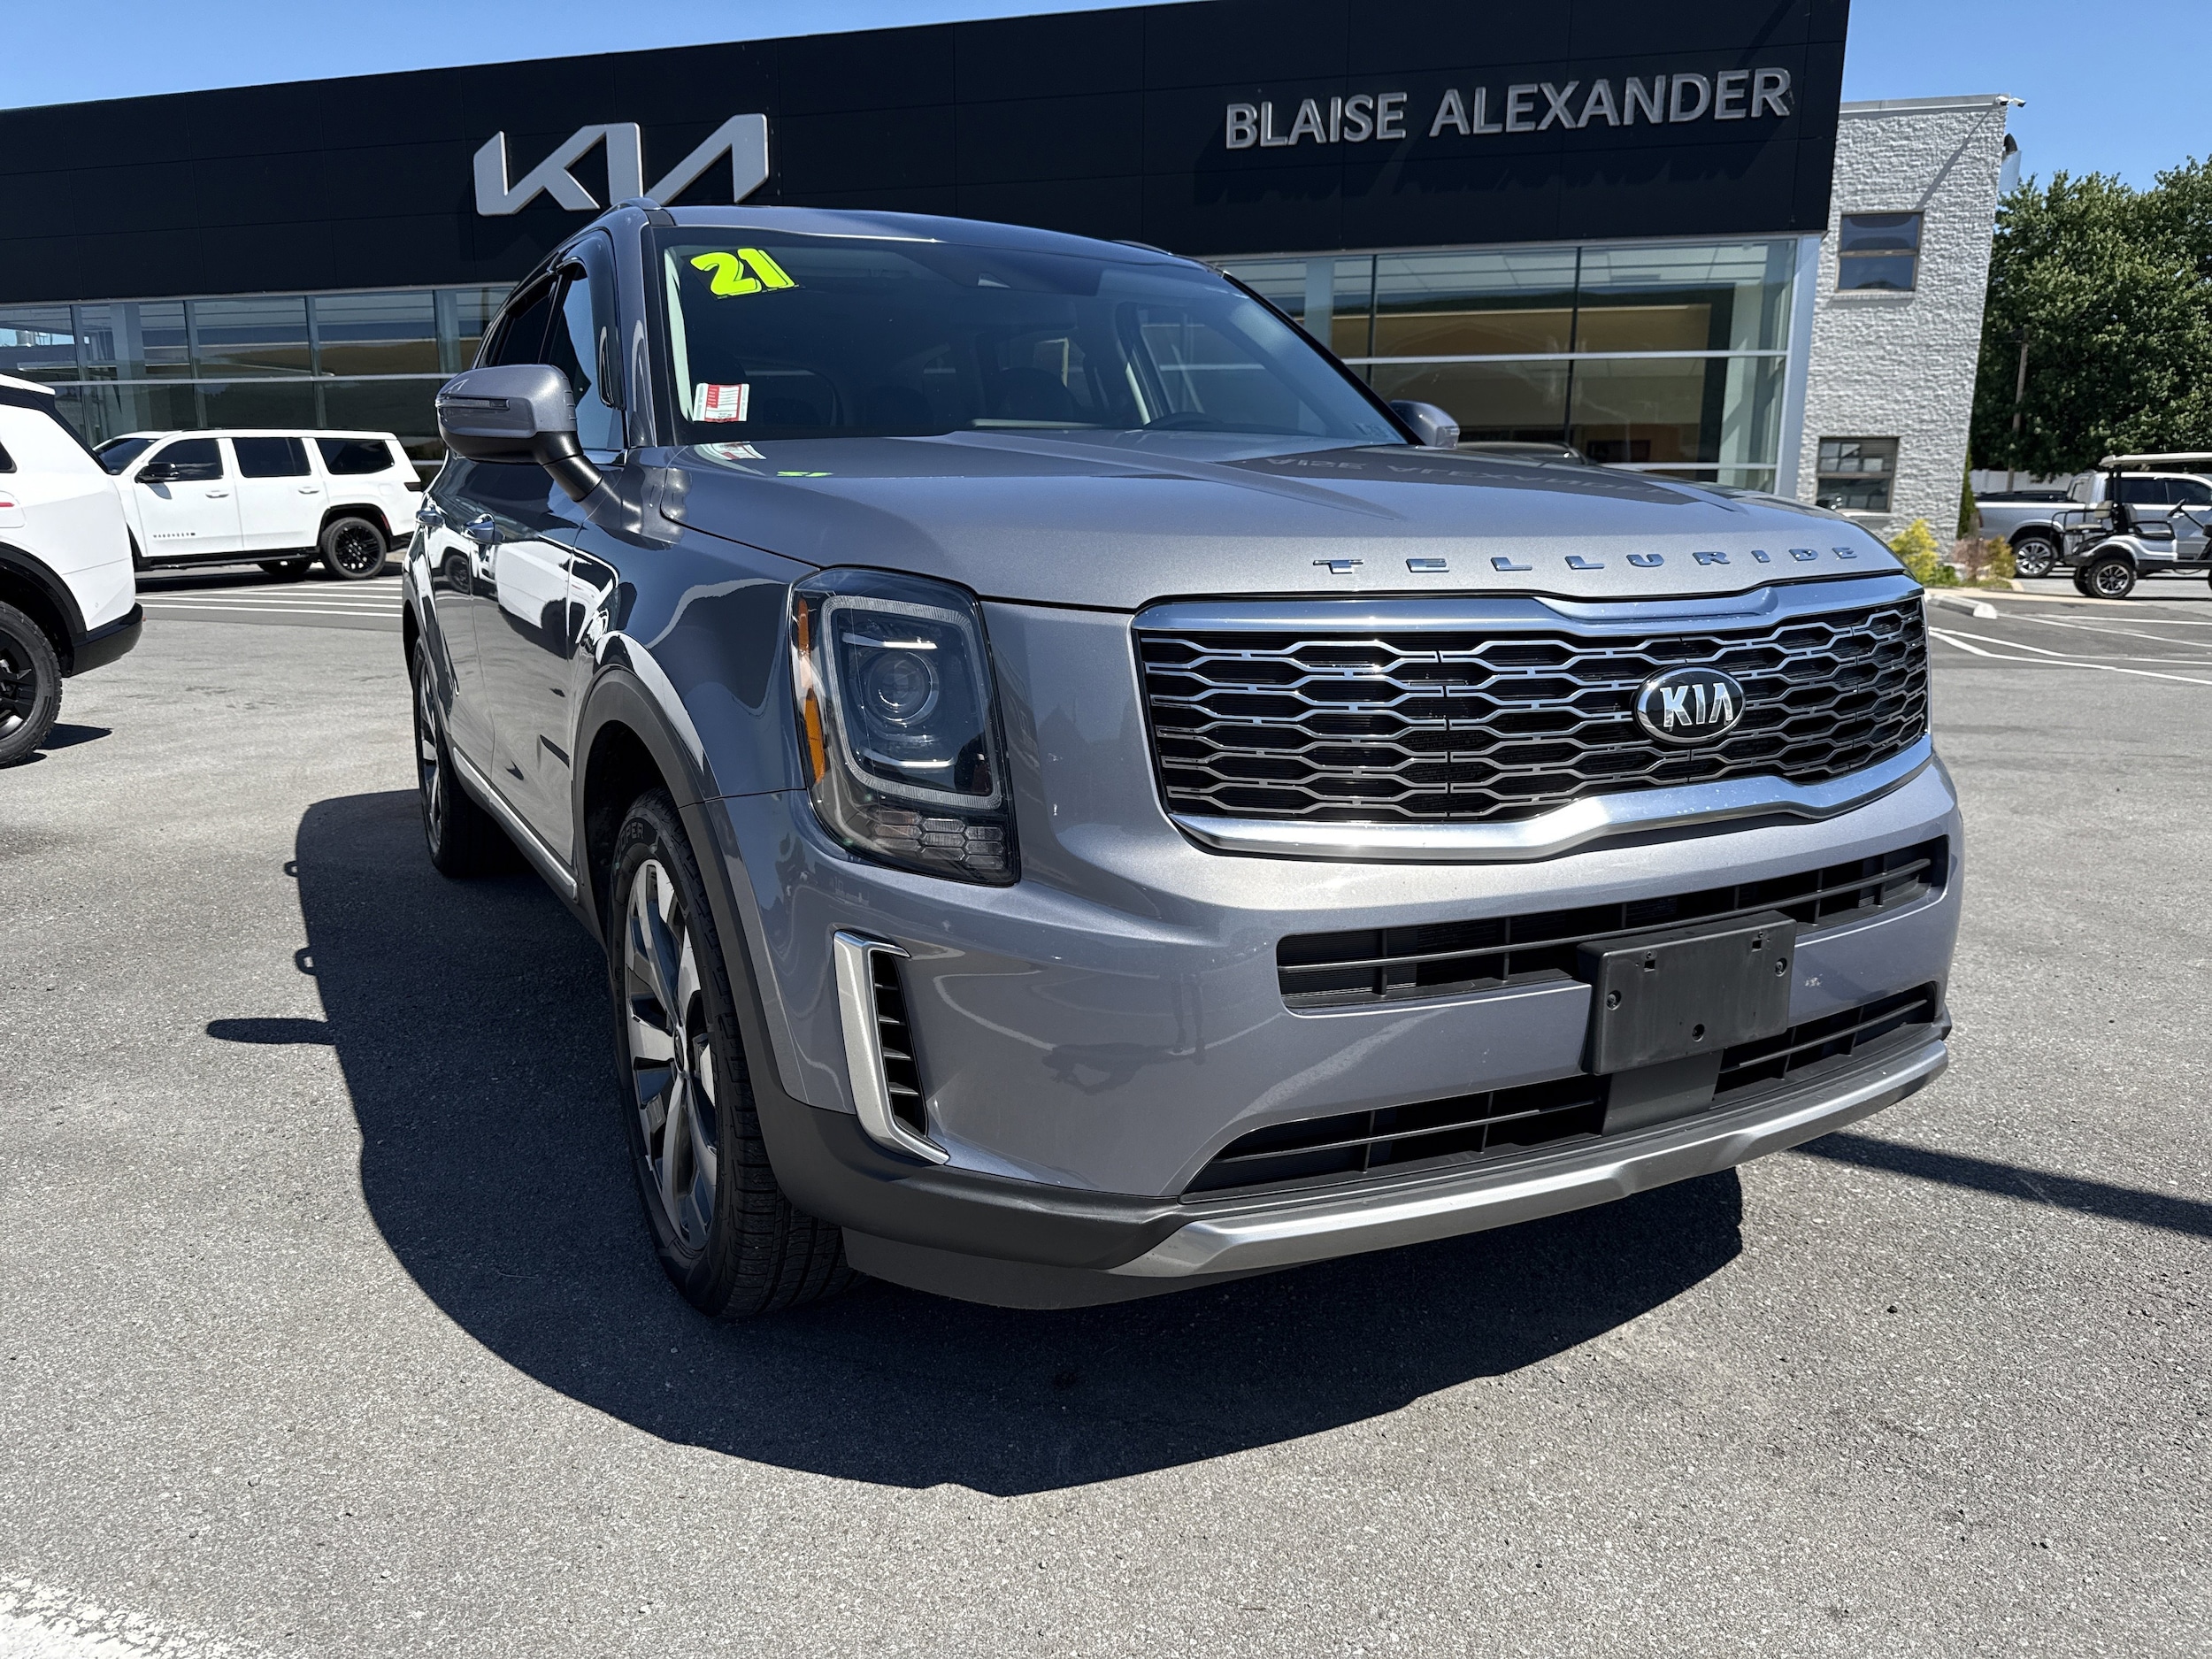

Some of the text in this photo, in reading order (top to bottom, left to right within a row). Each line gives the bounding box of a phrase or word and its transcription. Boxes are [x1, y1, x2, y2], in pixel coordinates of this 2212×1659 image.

[1226, 67, 1792, 149] BLAISE ALEXANDER
[473, 113, 769, 216] KIA
[690, 248, 795, 296] 21
[1313, 546, 1858, 574] TELLURIDE
[1660, 682, 1733, 727] KIA
